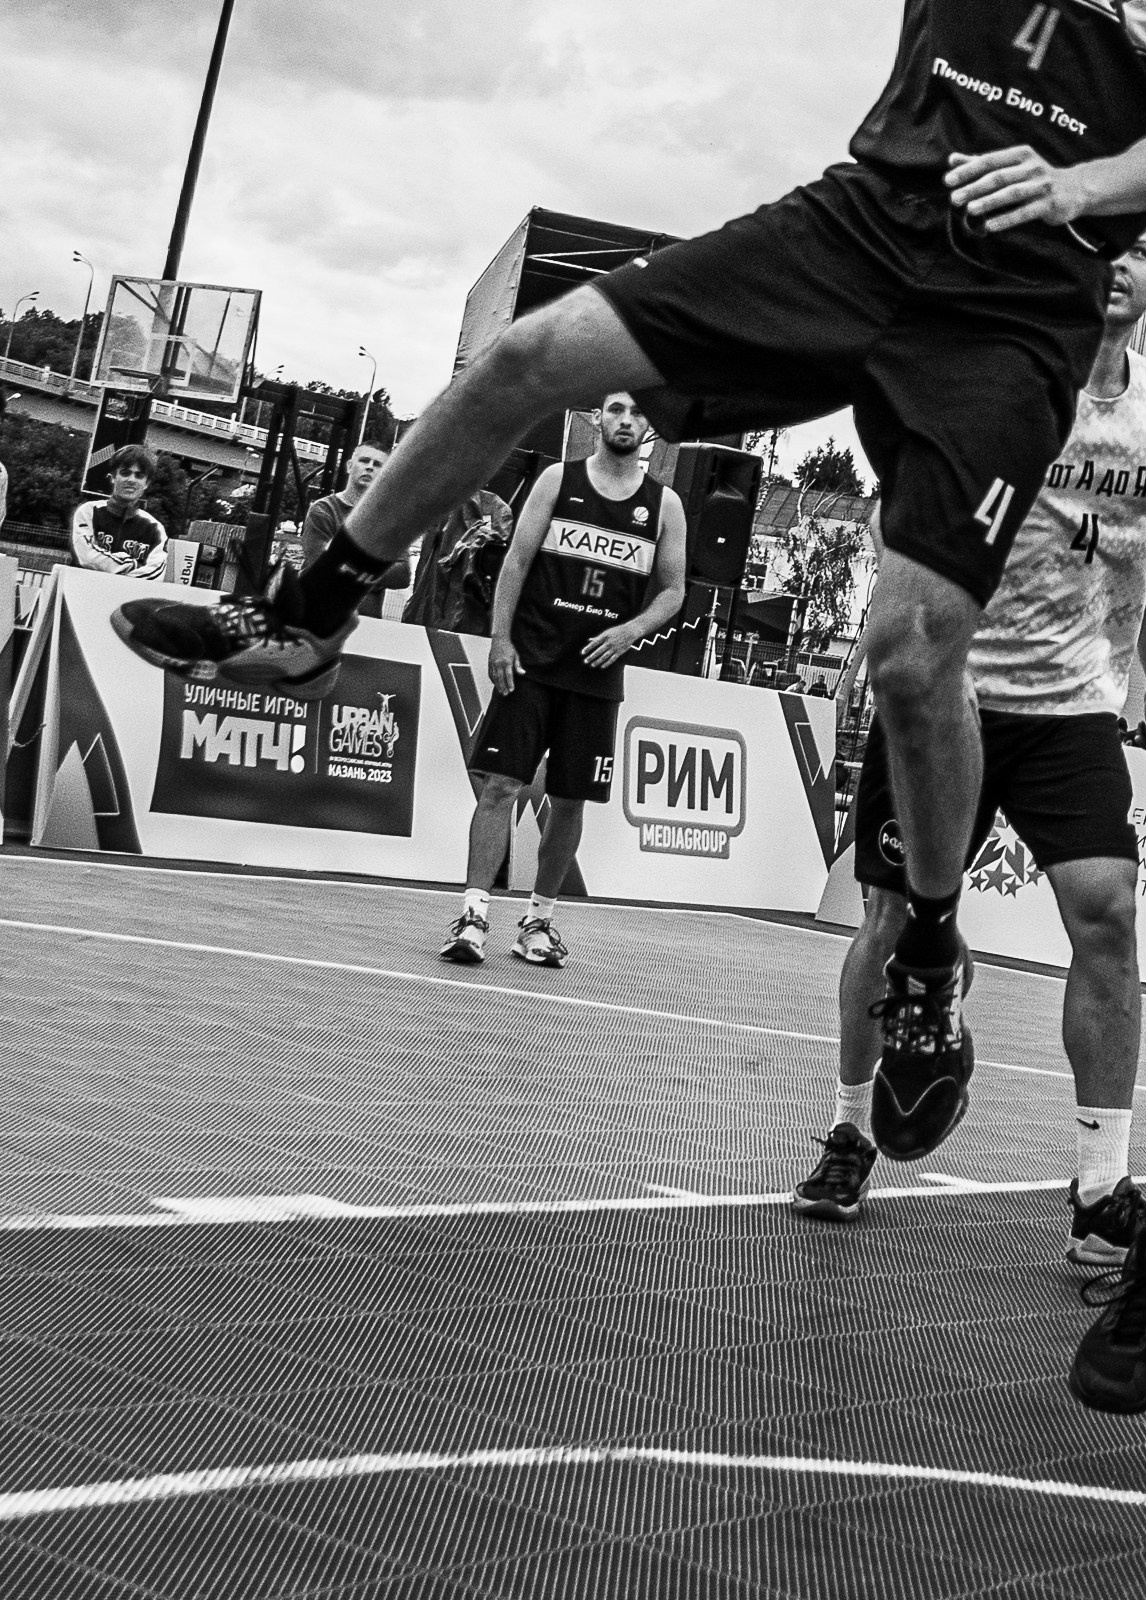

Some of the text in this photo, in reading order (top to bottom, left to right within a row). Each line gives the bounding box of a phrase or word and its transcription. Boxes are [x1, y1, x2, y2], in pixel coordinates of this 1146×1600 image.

[1012, 2, 1061, 71] 4
[932, 57, 1087, 136] Пионер Био Тест
[1047, 463, 1075, 489] ОТ
[1075, 460, 1095, 490] А
[1095, 469, 1130, 497] ДО
[974, 477, 1015, 546] 4
[559, 527, 641, 563] KAREX
[1069, 513, 1099, 564] 4
[582, 566, 607, 598] 15
[553, 597, 619, 619] Пионер Био Тест
[184, 684, 308, 719] УЛИЧНЫЕ ИГРЫ
[332, 704, 394, 736] URBAN
[180, 709, 307, 774] МАТЧ!
[329, 726, 382, 757] GAMES
[328, 763, 393, 783] КАЗАНЬ 2023
[593, 756, 613, 783] 15
[637, 739, 734, 814] РИМ
[642, 823, 727, 853] MEDIAGROUP
